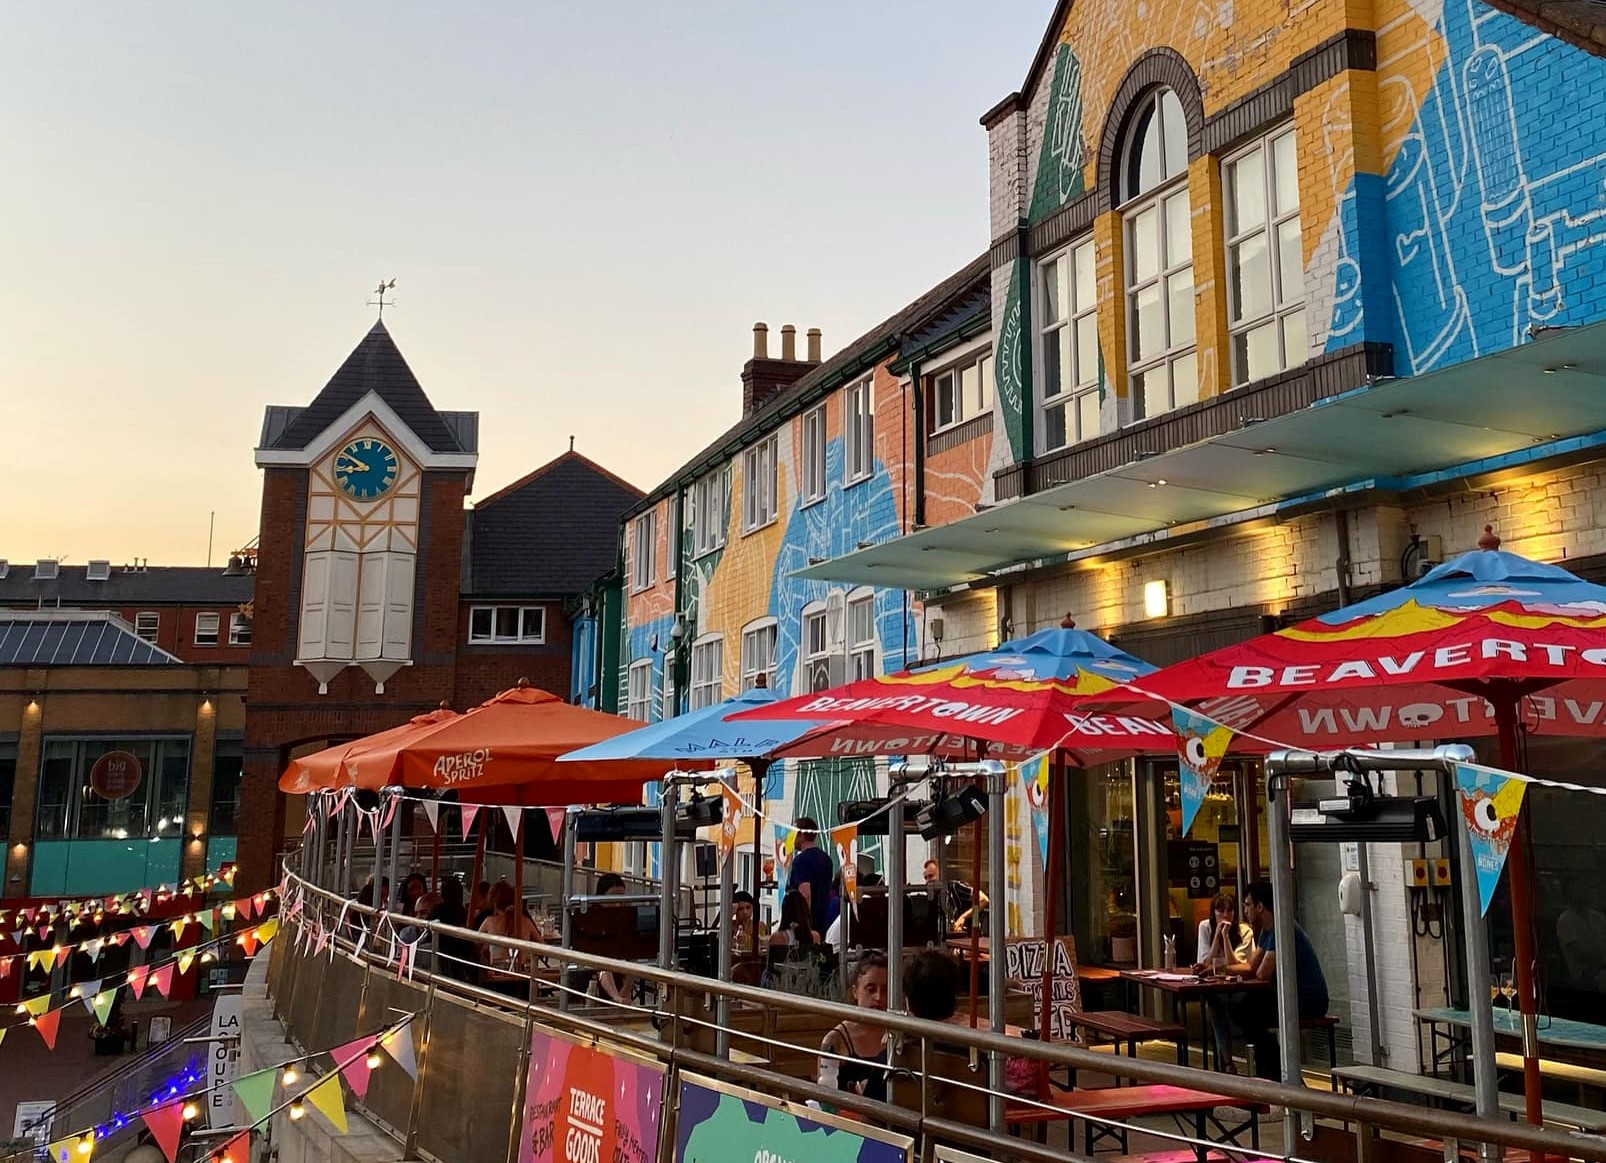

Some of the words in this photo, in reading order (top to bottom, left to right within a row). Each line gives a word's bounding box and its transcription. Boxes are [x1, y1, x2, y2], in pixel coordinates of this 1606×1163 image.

[796, 695, 1025, 725] BEAVERTOWN
[1063, 713, 1176, 735] BEAV
[433, 748, 494, 777] APEROL
[444, 764, 484, 785] SPRITZ
[219, 1015, 239, 1028] LA
[569, 1087, 606, 1126] TERRACE
[538, 1121, 555, 1158] BAR
[565, 1128, 601, 1163] GOODS
